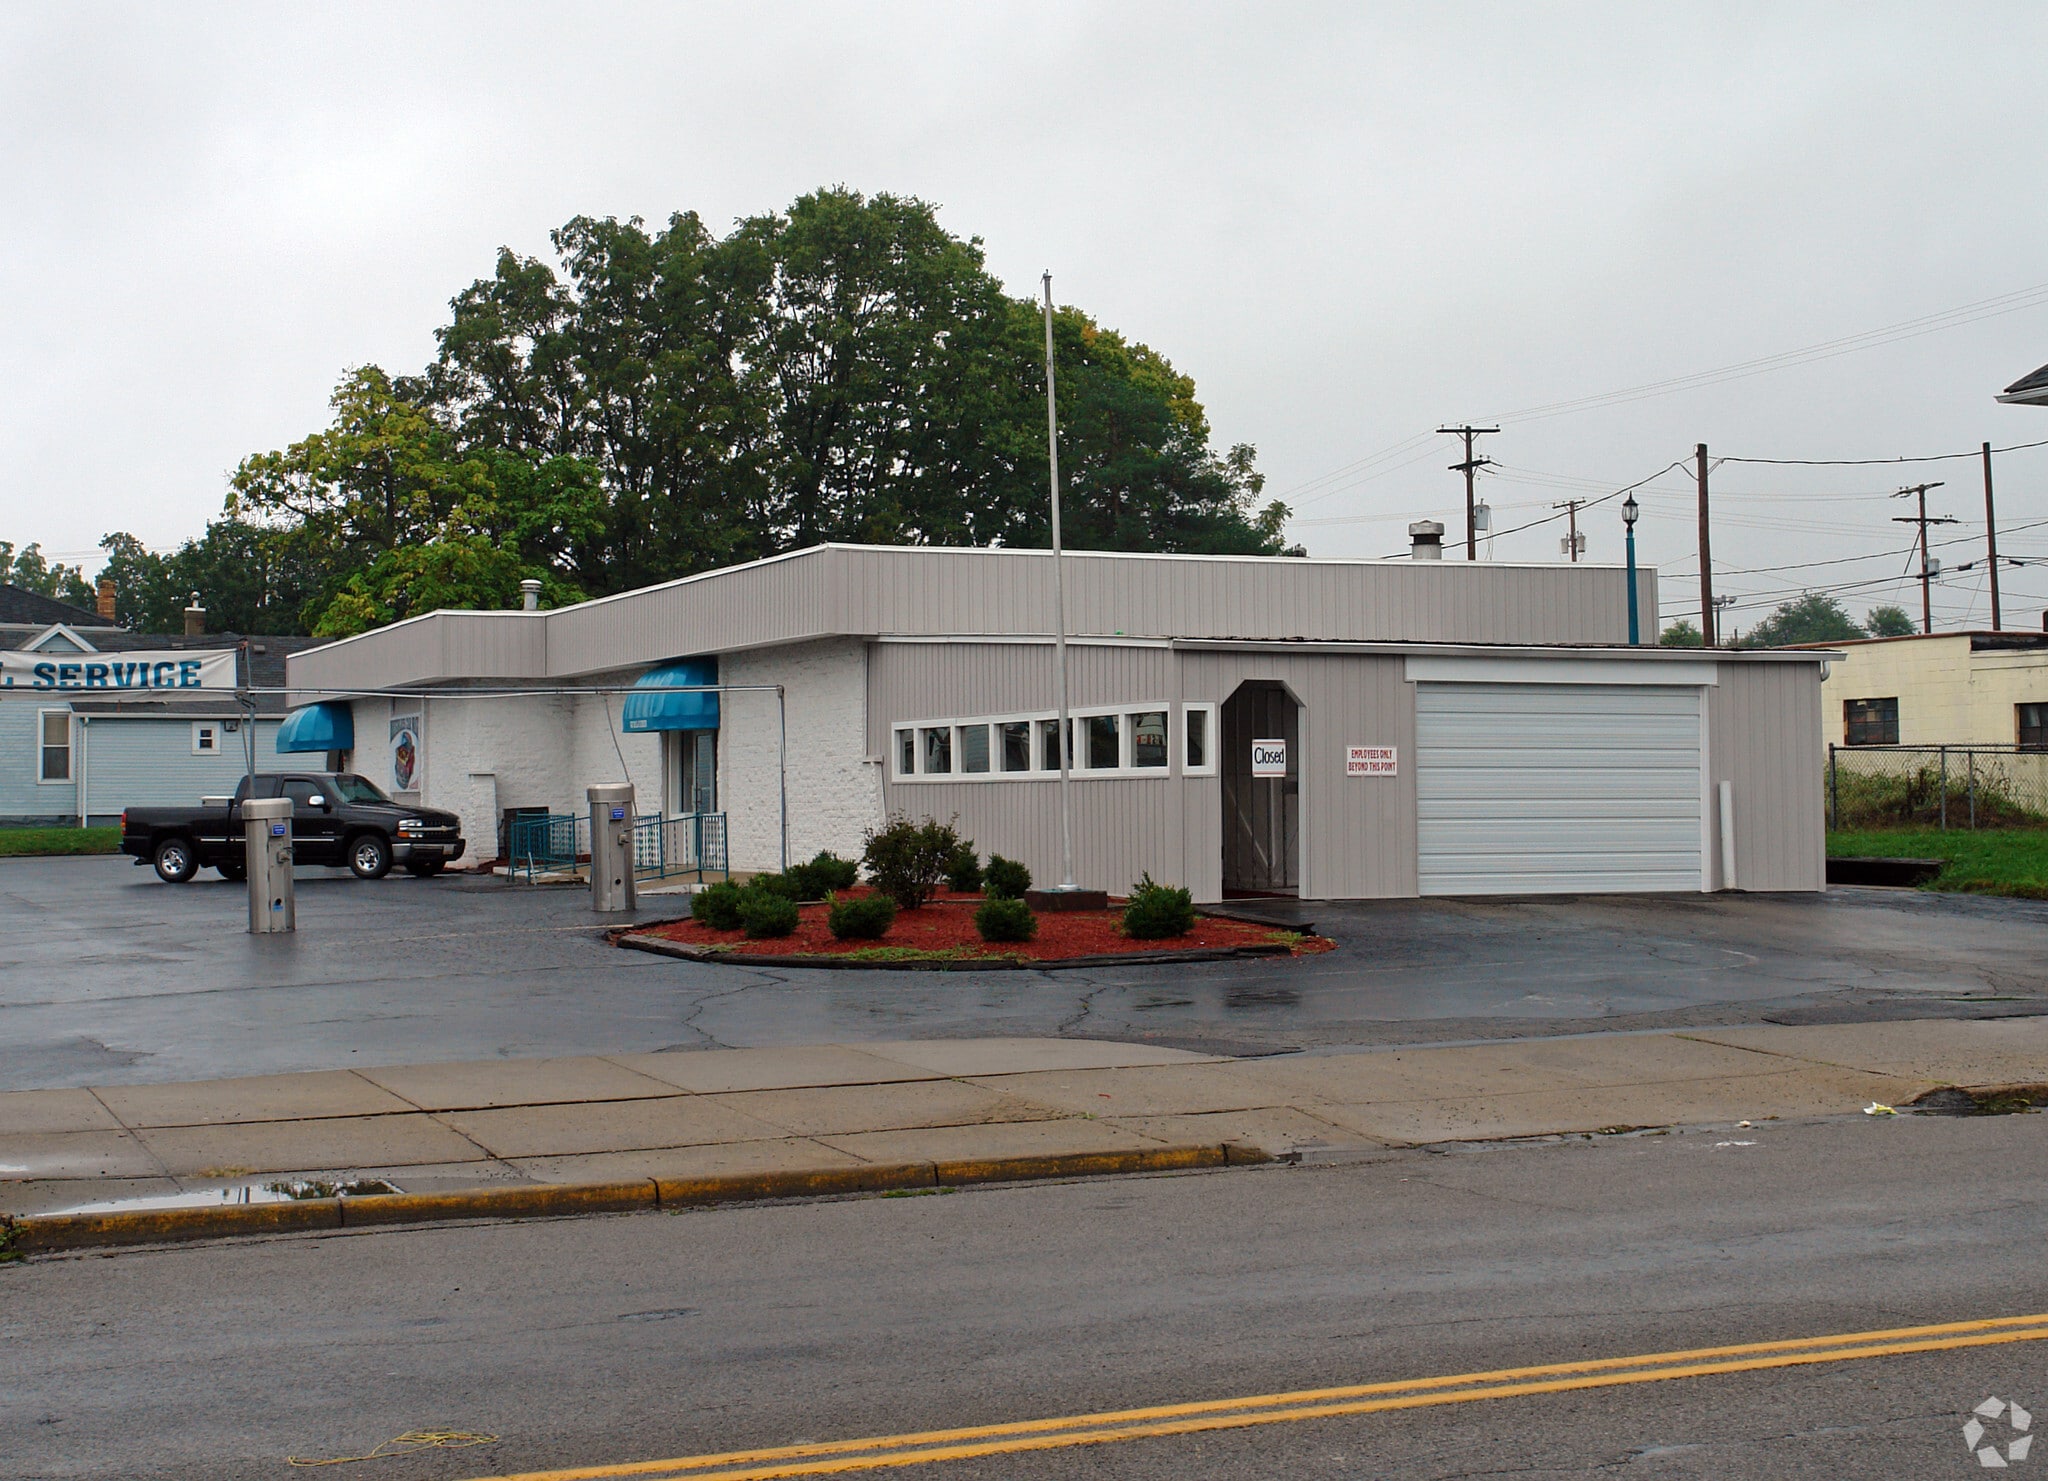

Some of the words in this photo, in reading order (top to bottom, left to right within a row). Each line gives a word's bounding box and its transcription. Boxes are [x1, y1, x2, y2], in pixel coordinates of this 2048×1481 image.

[33, 661, 202, 690] SERVICE
[1254, 747, 1284, 764] Closed
[1351, 750, 1379, 759] EMPLOYEES
[1380, 750, 1392, 759] ONLY
[1348, 761, 1368, 772] BEYOND
[1369, 761, 1380, 772] THIS
[1381, 761, 1396, 772] POINT
